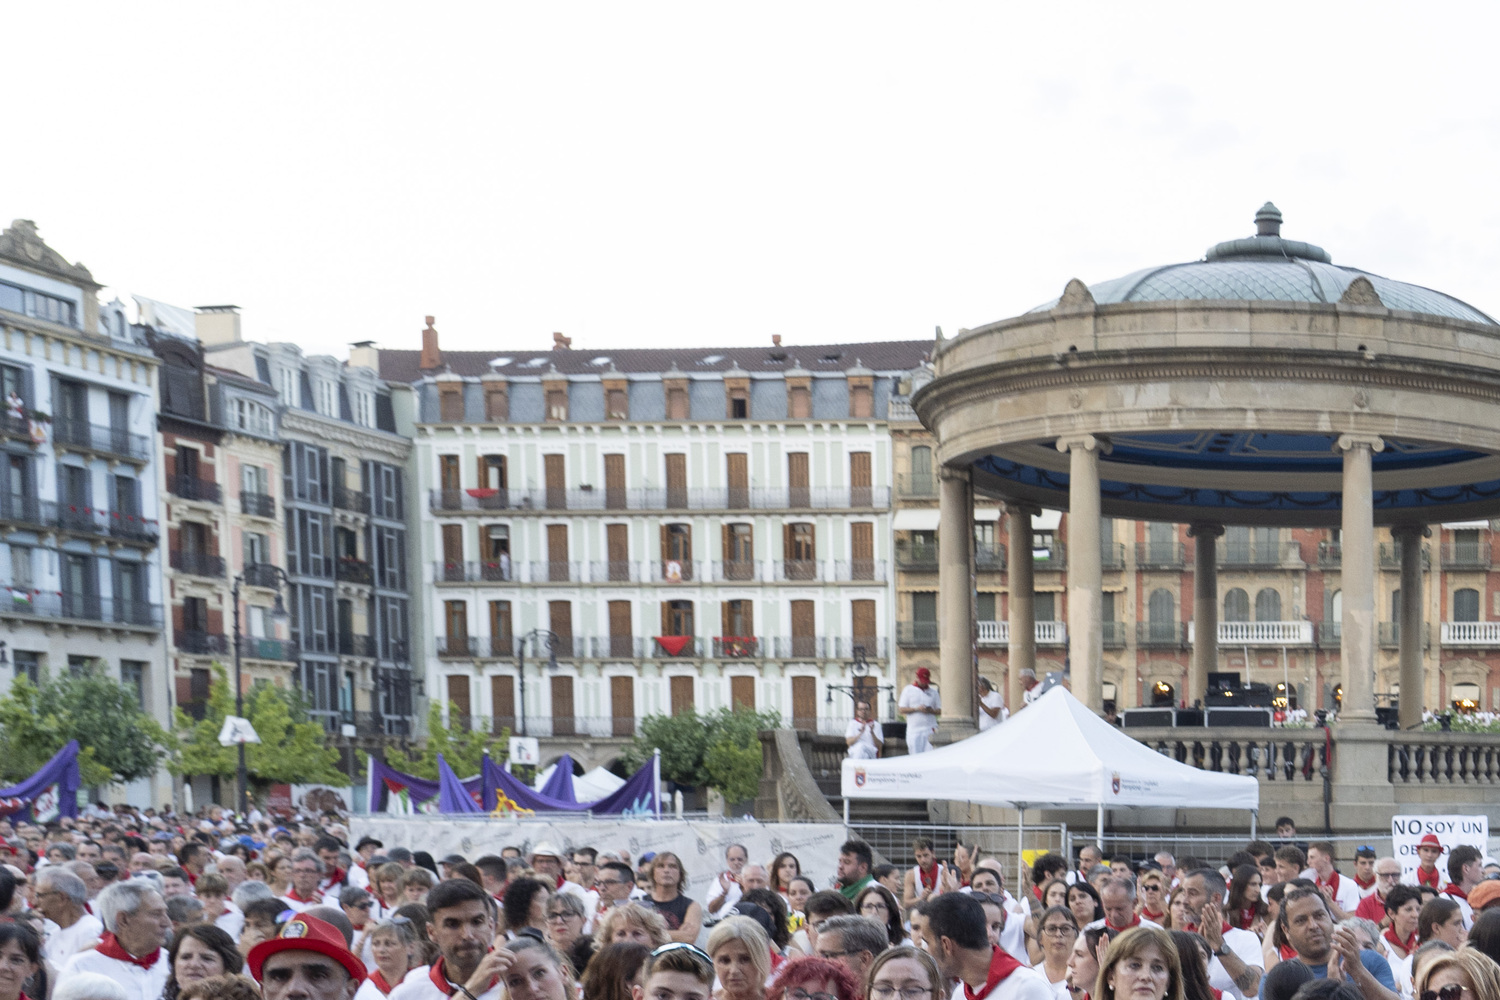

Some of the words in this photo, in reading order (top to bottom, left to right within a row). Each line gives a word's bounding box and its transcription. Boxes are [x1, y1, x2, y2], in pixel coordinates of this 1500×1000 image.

[1393, 820, 1422, 835] NO
[1425, 821, 1455, 834] SOY
[1461, 822, 1483, 834] UN
